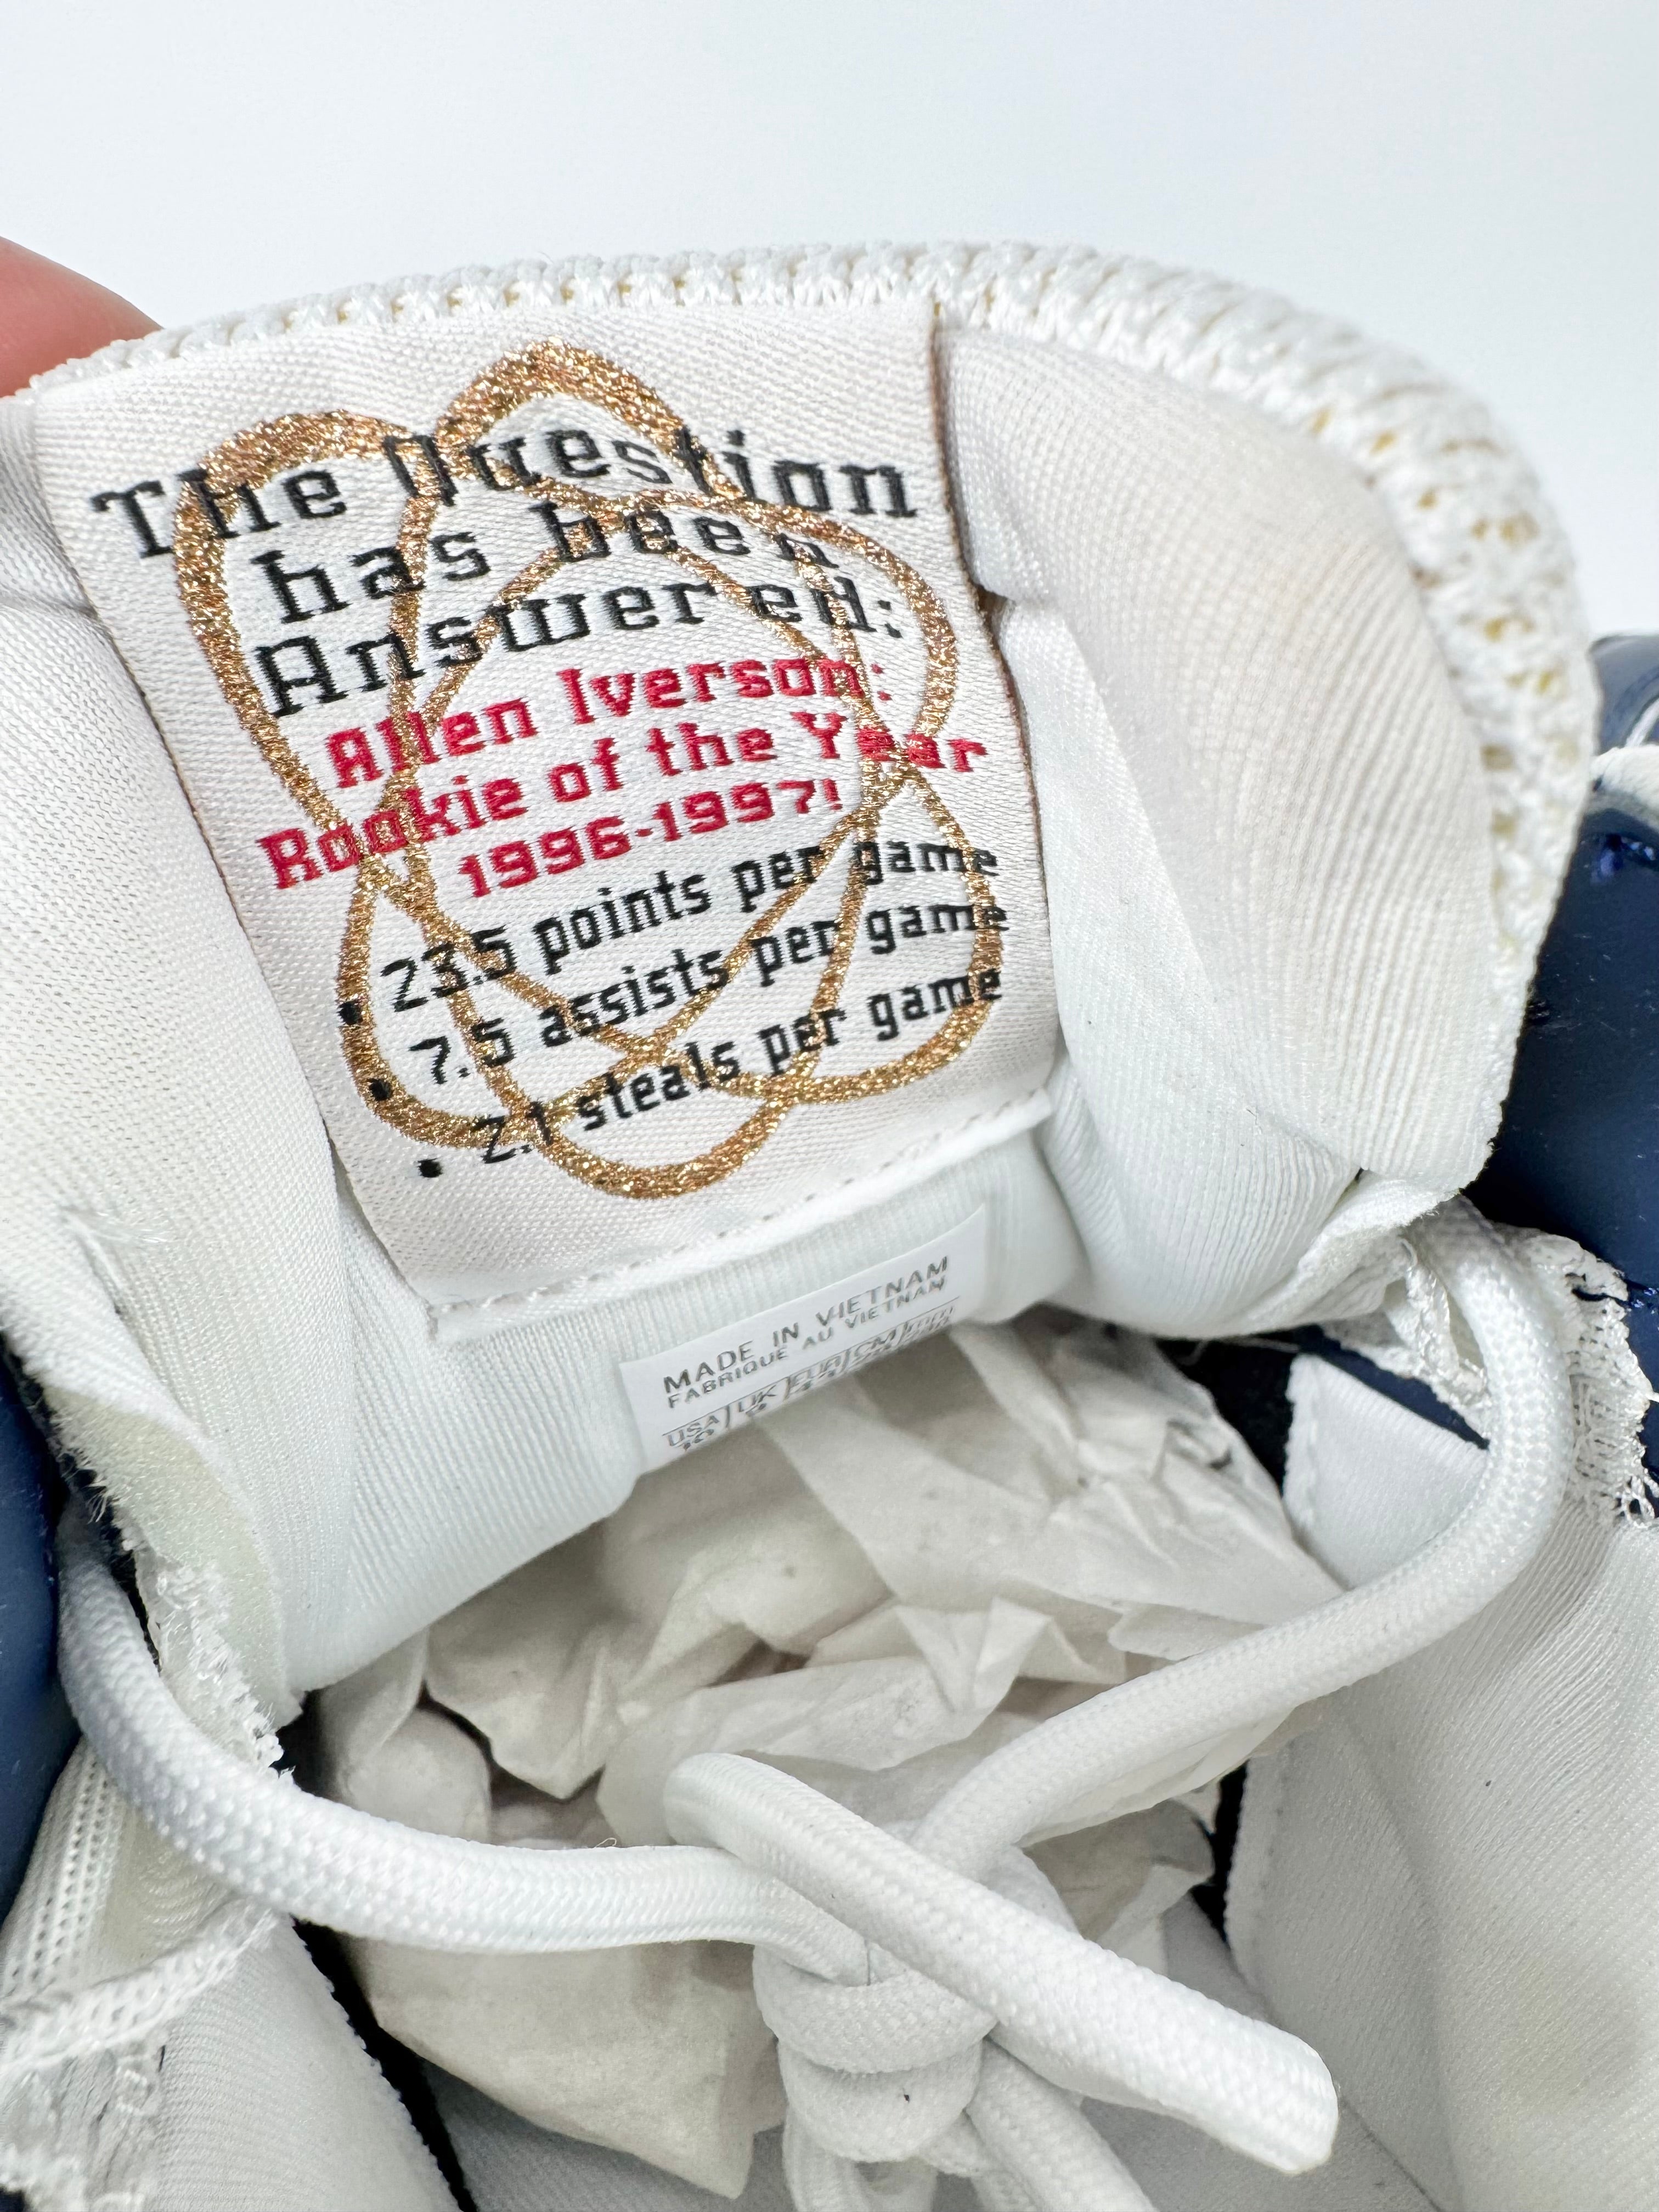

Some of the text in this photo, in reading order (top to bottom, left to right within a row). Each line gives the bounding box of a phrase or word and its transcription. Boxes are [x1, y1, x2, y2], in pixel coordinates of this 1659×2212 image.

[90, 429, 917, 558] The Question
[251, 500, 839, 624] has been
[255, 575, 902, 718] Answered:
[325, 658, 893, 789] Allen Iverson:
[256, 712, 988, 890] Rookie of the Year
[458, 777, 843, 898] 1996-1997!
[381, 841, 998, 1012] 23.5 points per game
[409, 904, 1009, 1085] 7.5 assists per game
[574, 1041, 741, 1131] steals
[758, 1007, 847, 1076] per
[867, 968, 1002, 1041] game
[663, 1340, 755, 1394] MADE
[772, 1322, 799, 1347] IN
[815, 1255, 949, 1327] VIETNAM
[667, 1345, 790, 1409] FABRIQUE
[801, 1325, 835, 1350] AU
[844, 1276, 946, 1329] VIETNAM
[667, 1414, 720, 1447] USA
